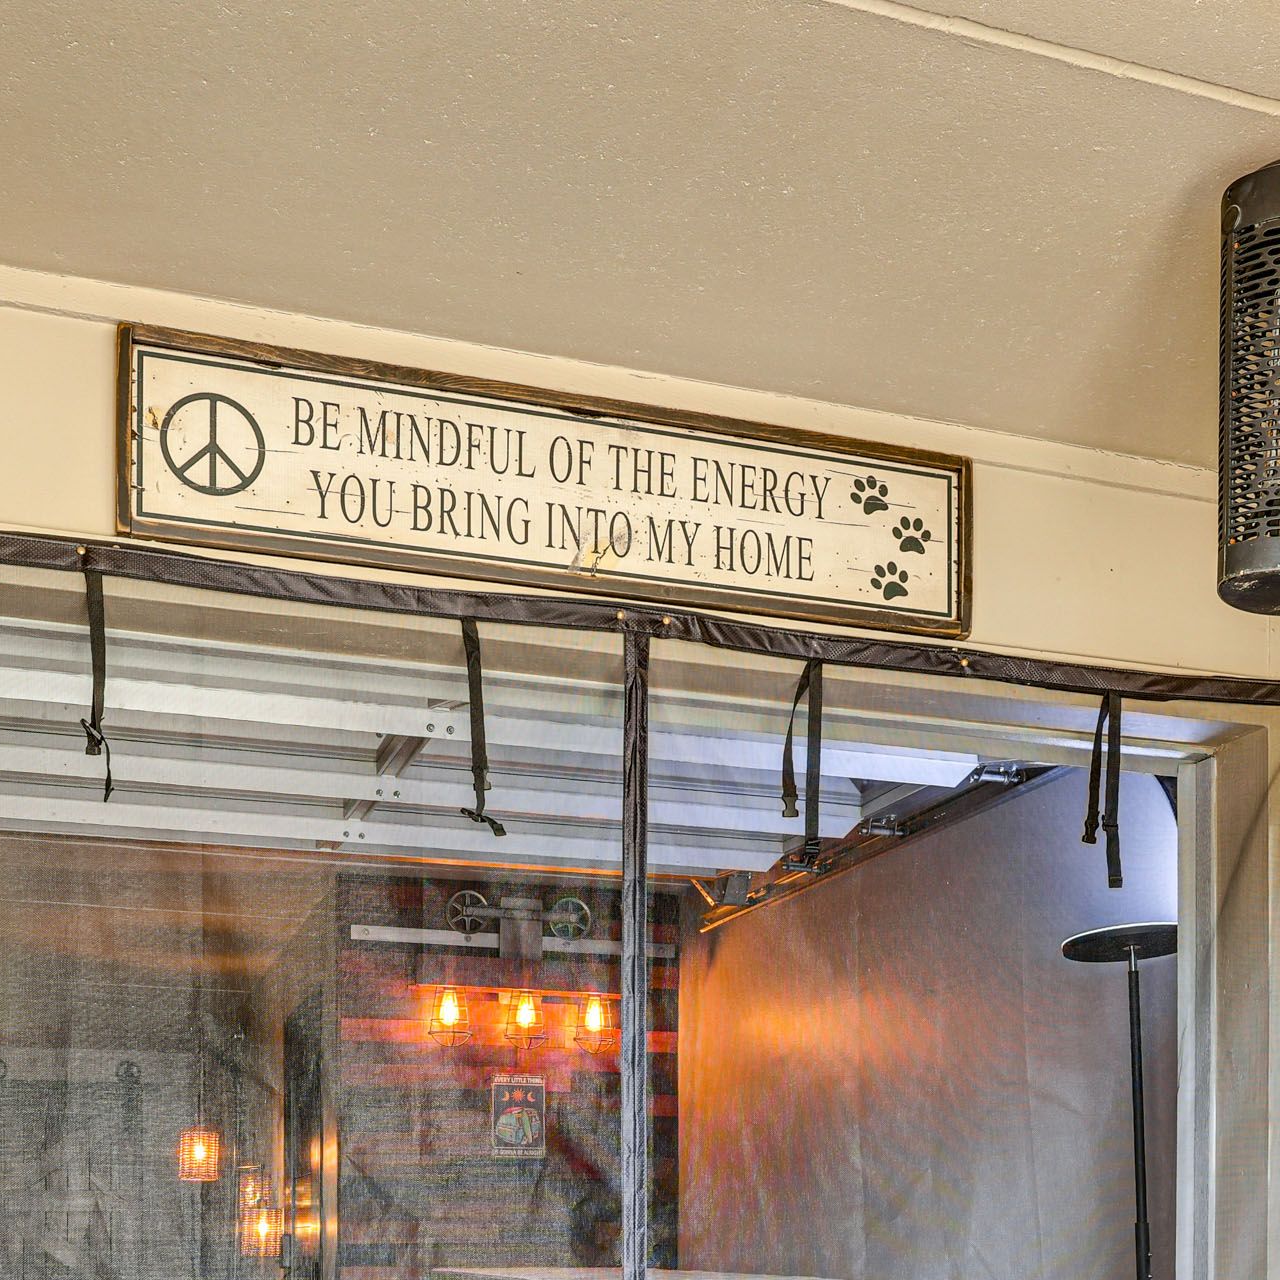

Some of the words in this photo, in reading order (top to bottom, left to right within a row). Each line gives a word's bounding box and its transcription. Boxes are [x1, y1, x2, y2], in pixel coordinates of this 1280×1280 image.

[290, 396, 342, 451] BE
[356, 406, 537, 479] MINDFUL
[549, 435, 595, 486] OF
[607, 443, 678, 499] THE
[690, 455, 832, 520] ENERGY
[309, 469, 397, 528] YOU
[410, 483, 533, 546] BRING
[545, 501, 633, 559] INTO
[646, 515, 702, 567] MY
[713, 524, 815, 582] HOME
